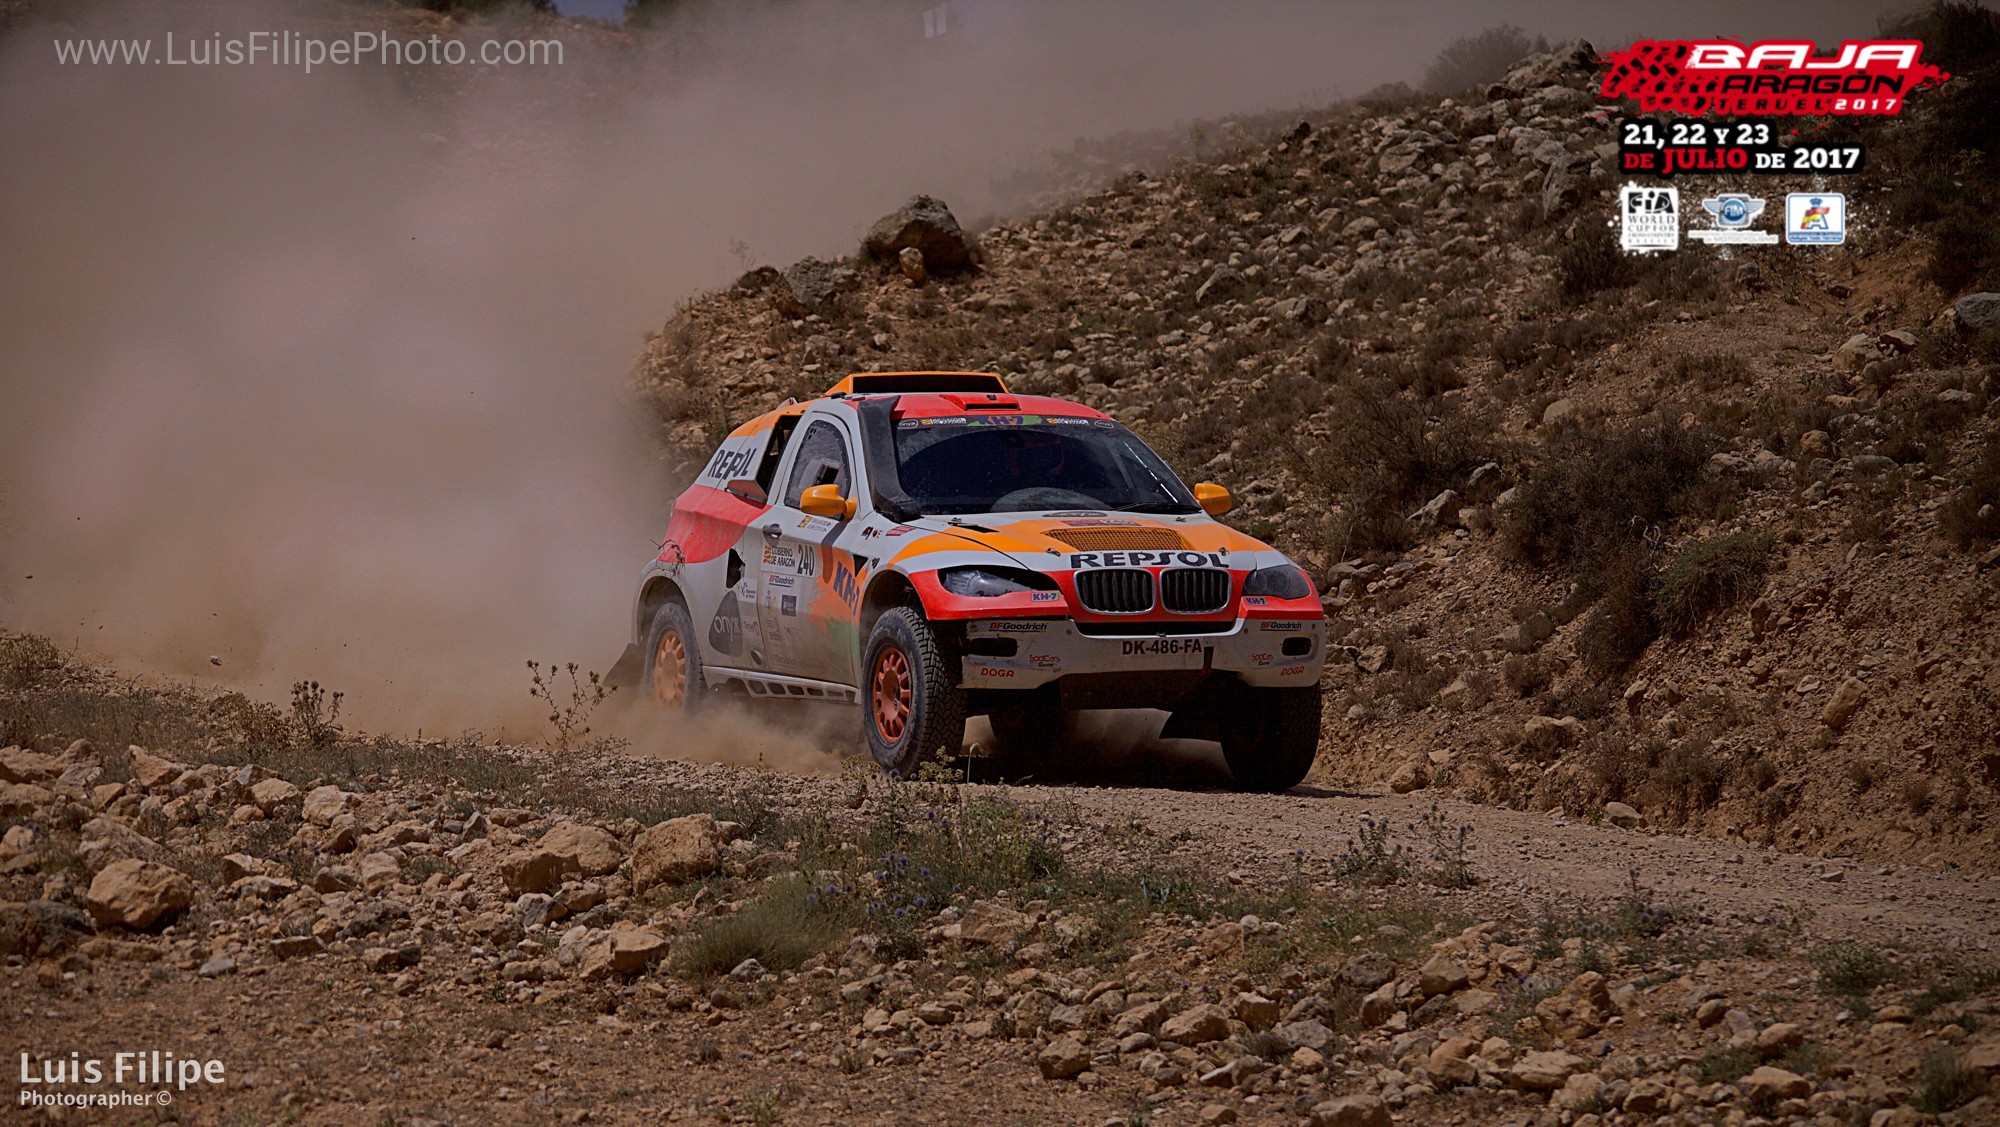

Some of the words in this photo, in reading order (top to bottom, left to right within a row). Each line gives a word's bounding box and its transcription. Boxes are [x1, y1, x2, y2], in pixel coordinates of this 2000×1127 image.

[797, 544, 815, 576] 240
[1070, 552, 1229, 569] REPSOL
[769, 574, 795, 585] BFGoodrich
[1032, 592, 1058, 601] KH-7
[1245, 597, 1267, 605] KH-7
[989, 622, 1048, 631] BFGoodrich
[1260, 622, 1302, 630] BFGoodrich
[1122, 639, 1203, 655] DK-486-FA
[981, 667, 1015, 678] DOGA
[1280, 666, 1305, 676] DOGA
